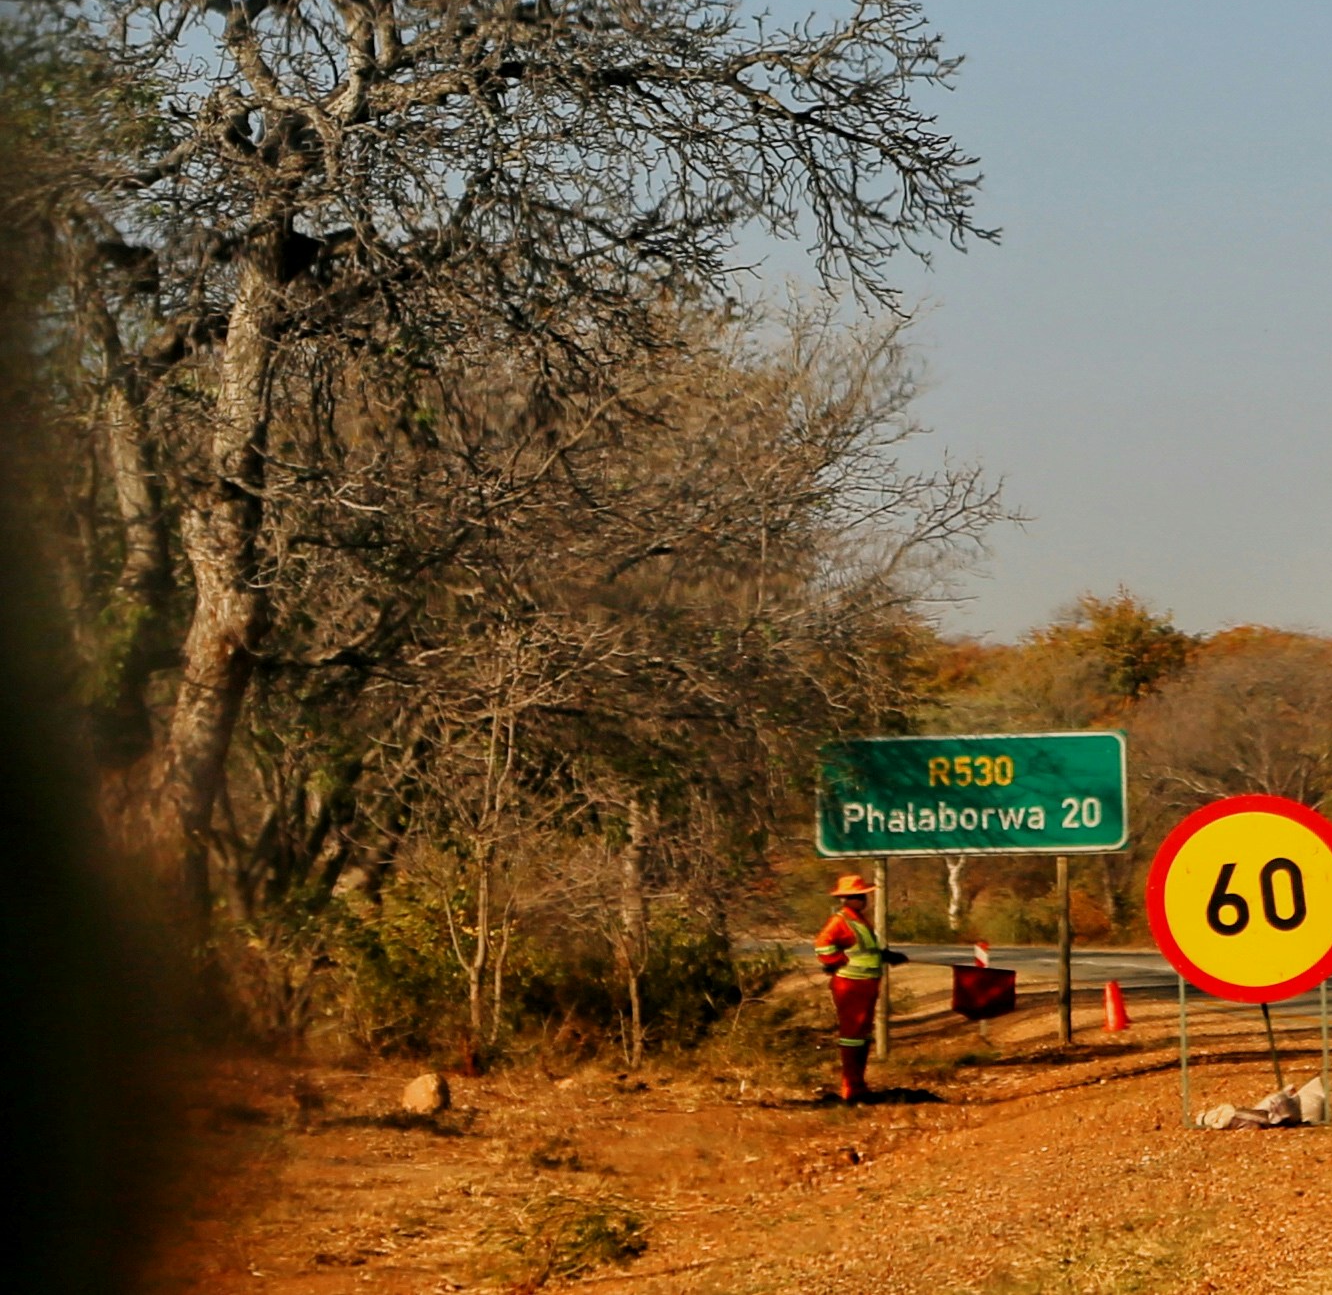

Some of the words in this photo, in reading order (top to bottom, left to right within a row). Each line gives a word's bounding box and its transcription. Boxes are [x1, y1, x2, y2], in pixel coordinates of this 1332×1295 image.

[928, 755, 1014, 788] R530
[842, 800, 1046, 835] Phalaborwa
[1061, 796, 1102, 830] 20
[1206, 857, 1307, 936] 60
